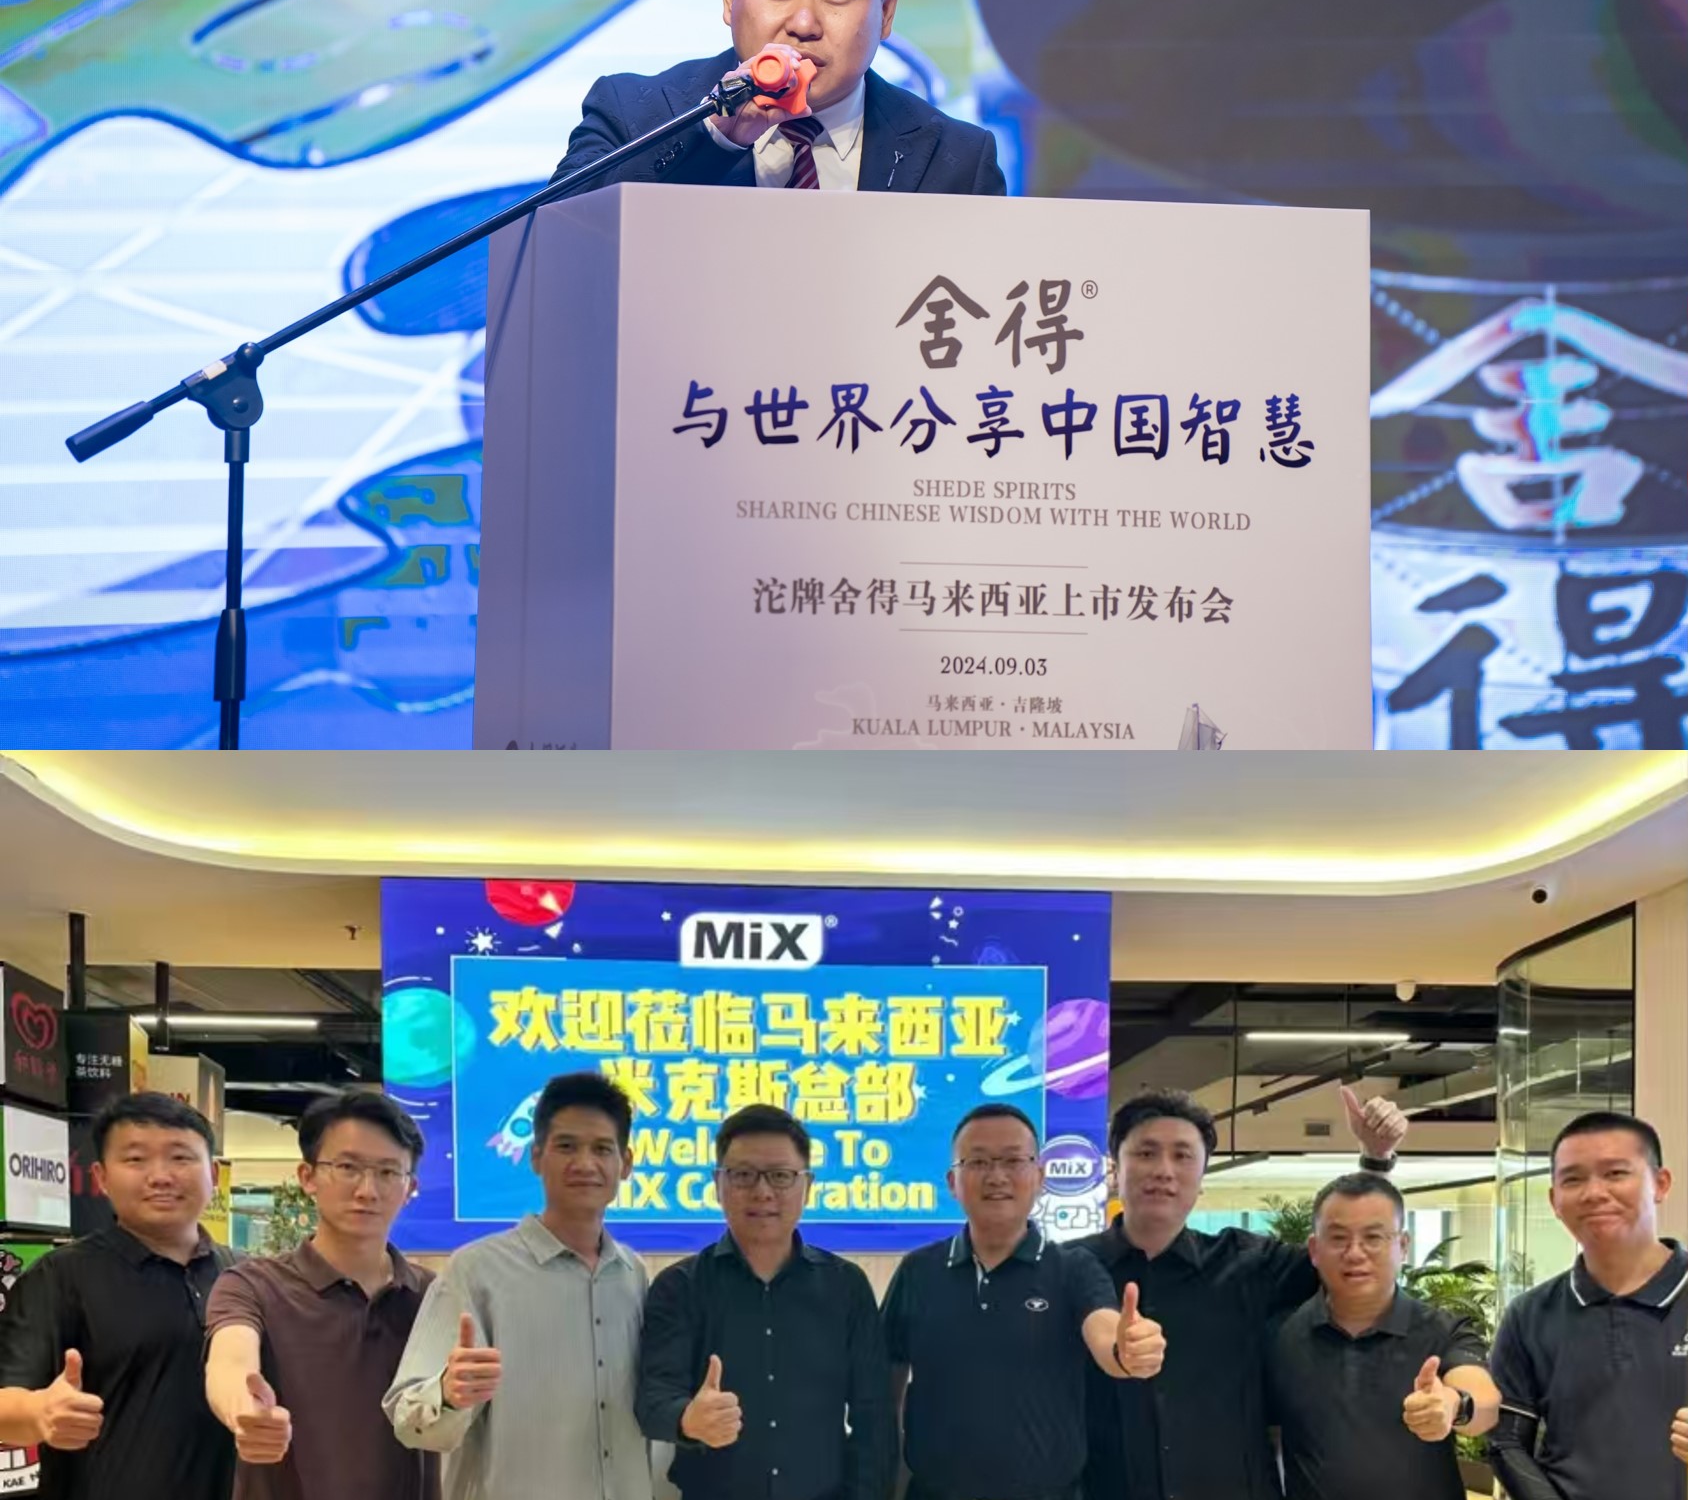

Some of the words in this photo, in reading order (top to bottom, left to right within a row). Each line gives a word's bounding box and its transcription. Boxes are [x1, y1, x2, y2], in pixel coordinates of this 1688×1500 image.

[672, 379, 1316, 469] 与世界分享中国智慧
[912, 479, 986, 498] SHEDE
[993, 481, 1077, 501] SPIRITS
[736, 499, 838, 520] SHARING
[846, 502, 941, 523] CHINESE
[949, 504, 1043, 525] WISDOM
[1050, 507, 1110, 526] WITH
[1116, 509, 1163, 528] THE
[1169, 511, 1251, 531] WORLD
[752, 575, 1235, 624] 沱牌舍得马来西亚上市发布会
[940, 655, 1048, 677] 2024.09.03
[852, 718, 920, 736] KUALA
[926, 719, 1012, 738] LUMPUR
[1032, 721, 1136, 740] MALAYSIA
[489, 987, 1013, 1058] 欢迎莅临马来西亚
[834, 1130, 890, 1167] To
[9, 1152, 66, 1184] ORIHIRO
[1047, 1158, 1089, 1179] MiX
